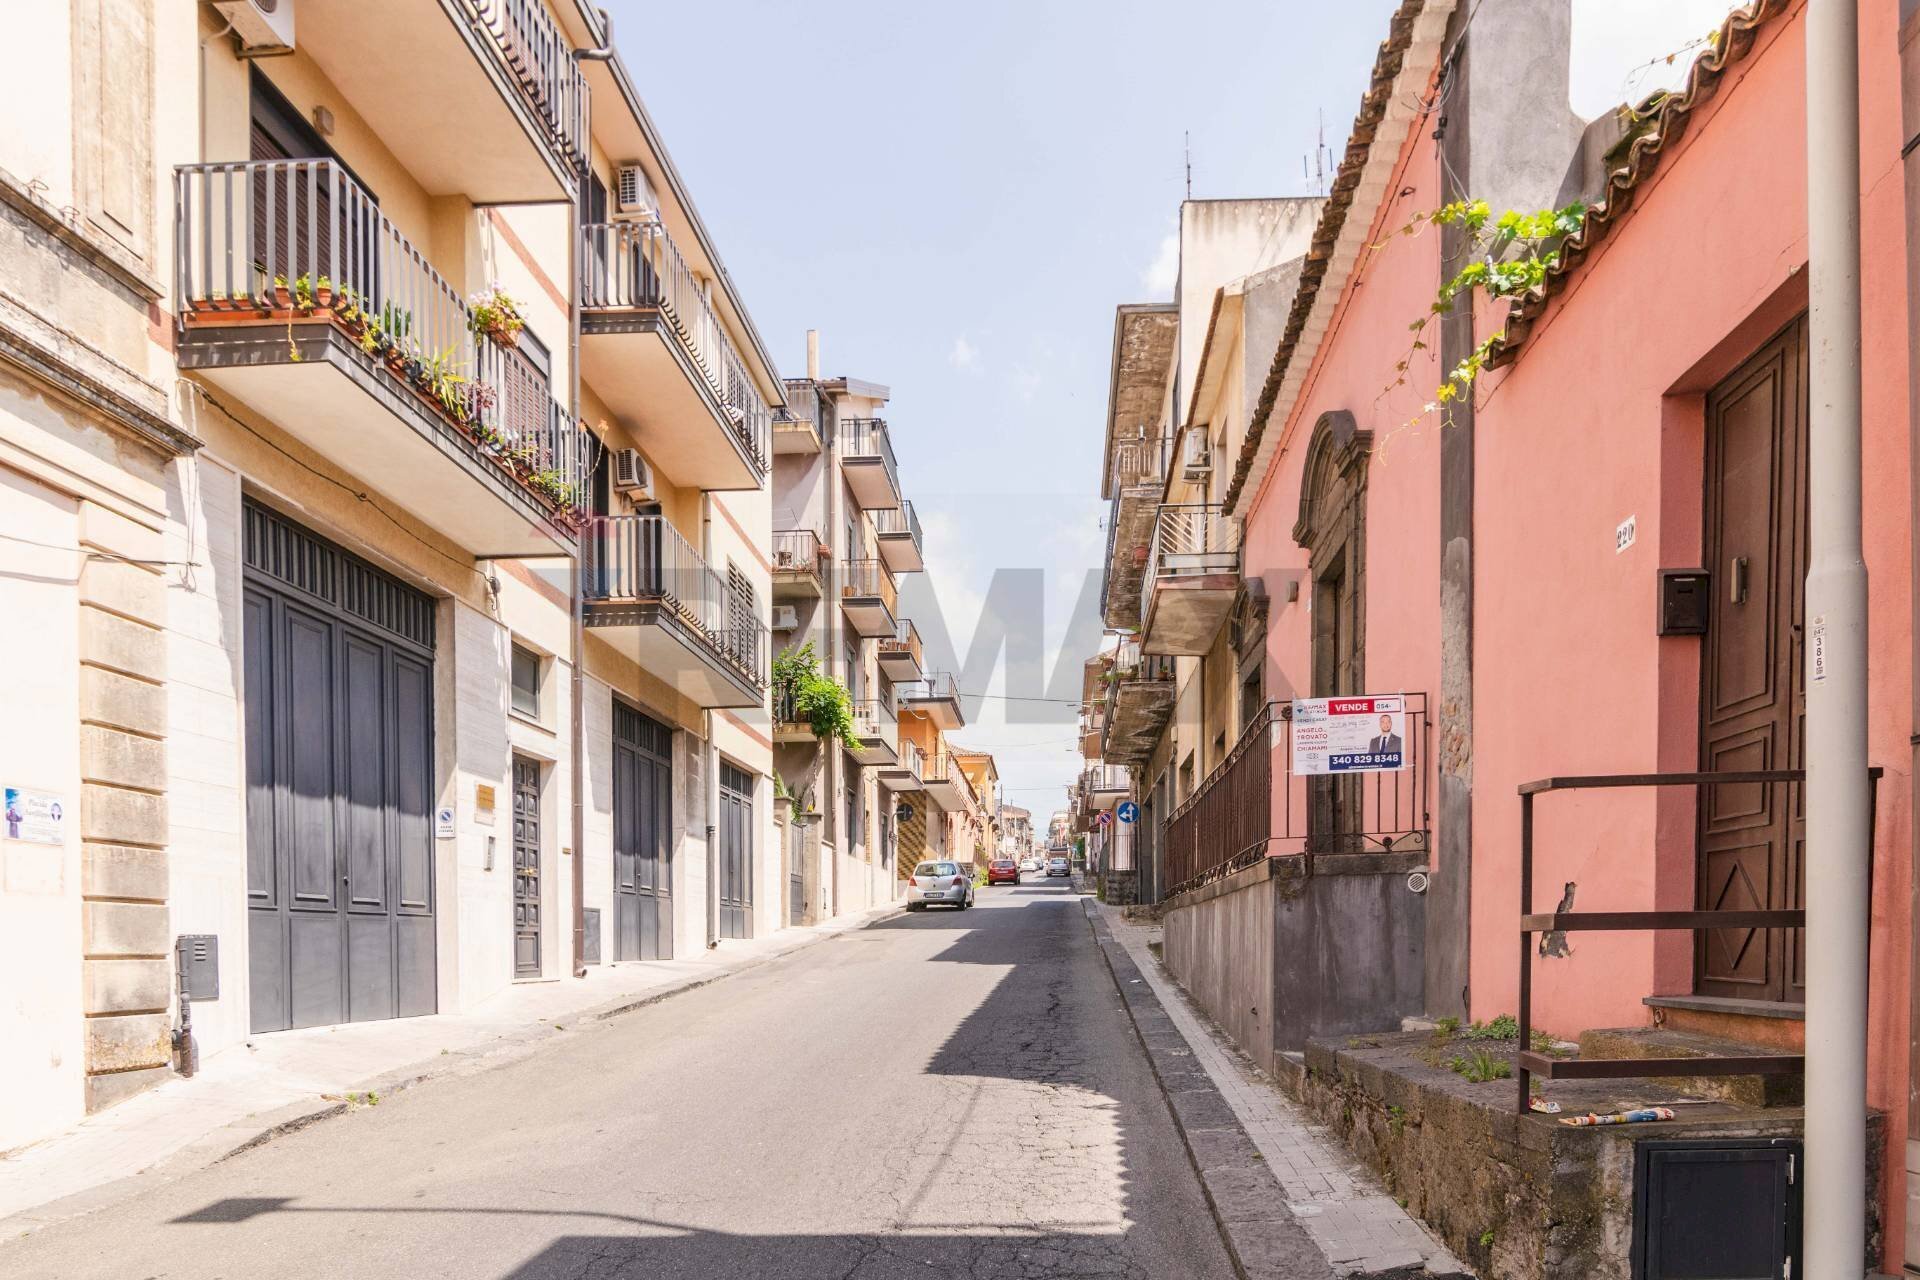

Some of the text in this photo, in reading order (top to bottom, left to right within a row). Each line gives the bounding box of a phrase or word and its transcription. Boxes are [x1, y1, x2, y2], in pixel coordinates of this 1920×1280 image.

[1616, 523, 1634, 549] 220
[1335, 702, 1368, 711] VENDE
[1332, 754, 1399, 764] 340 829 8348
